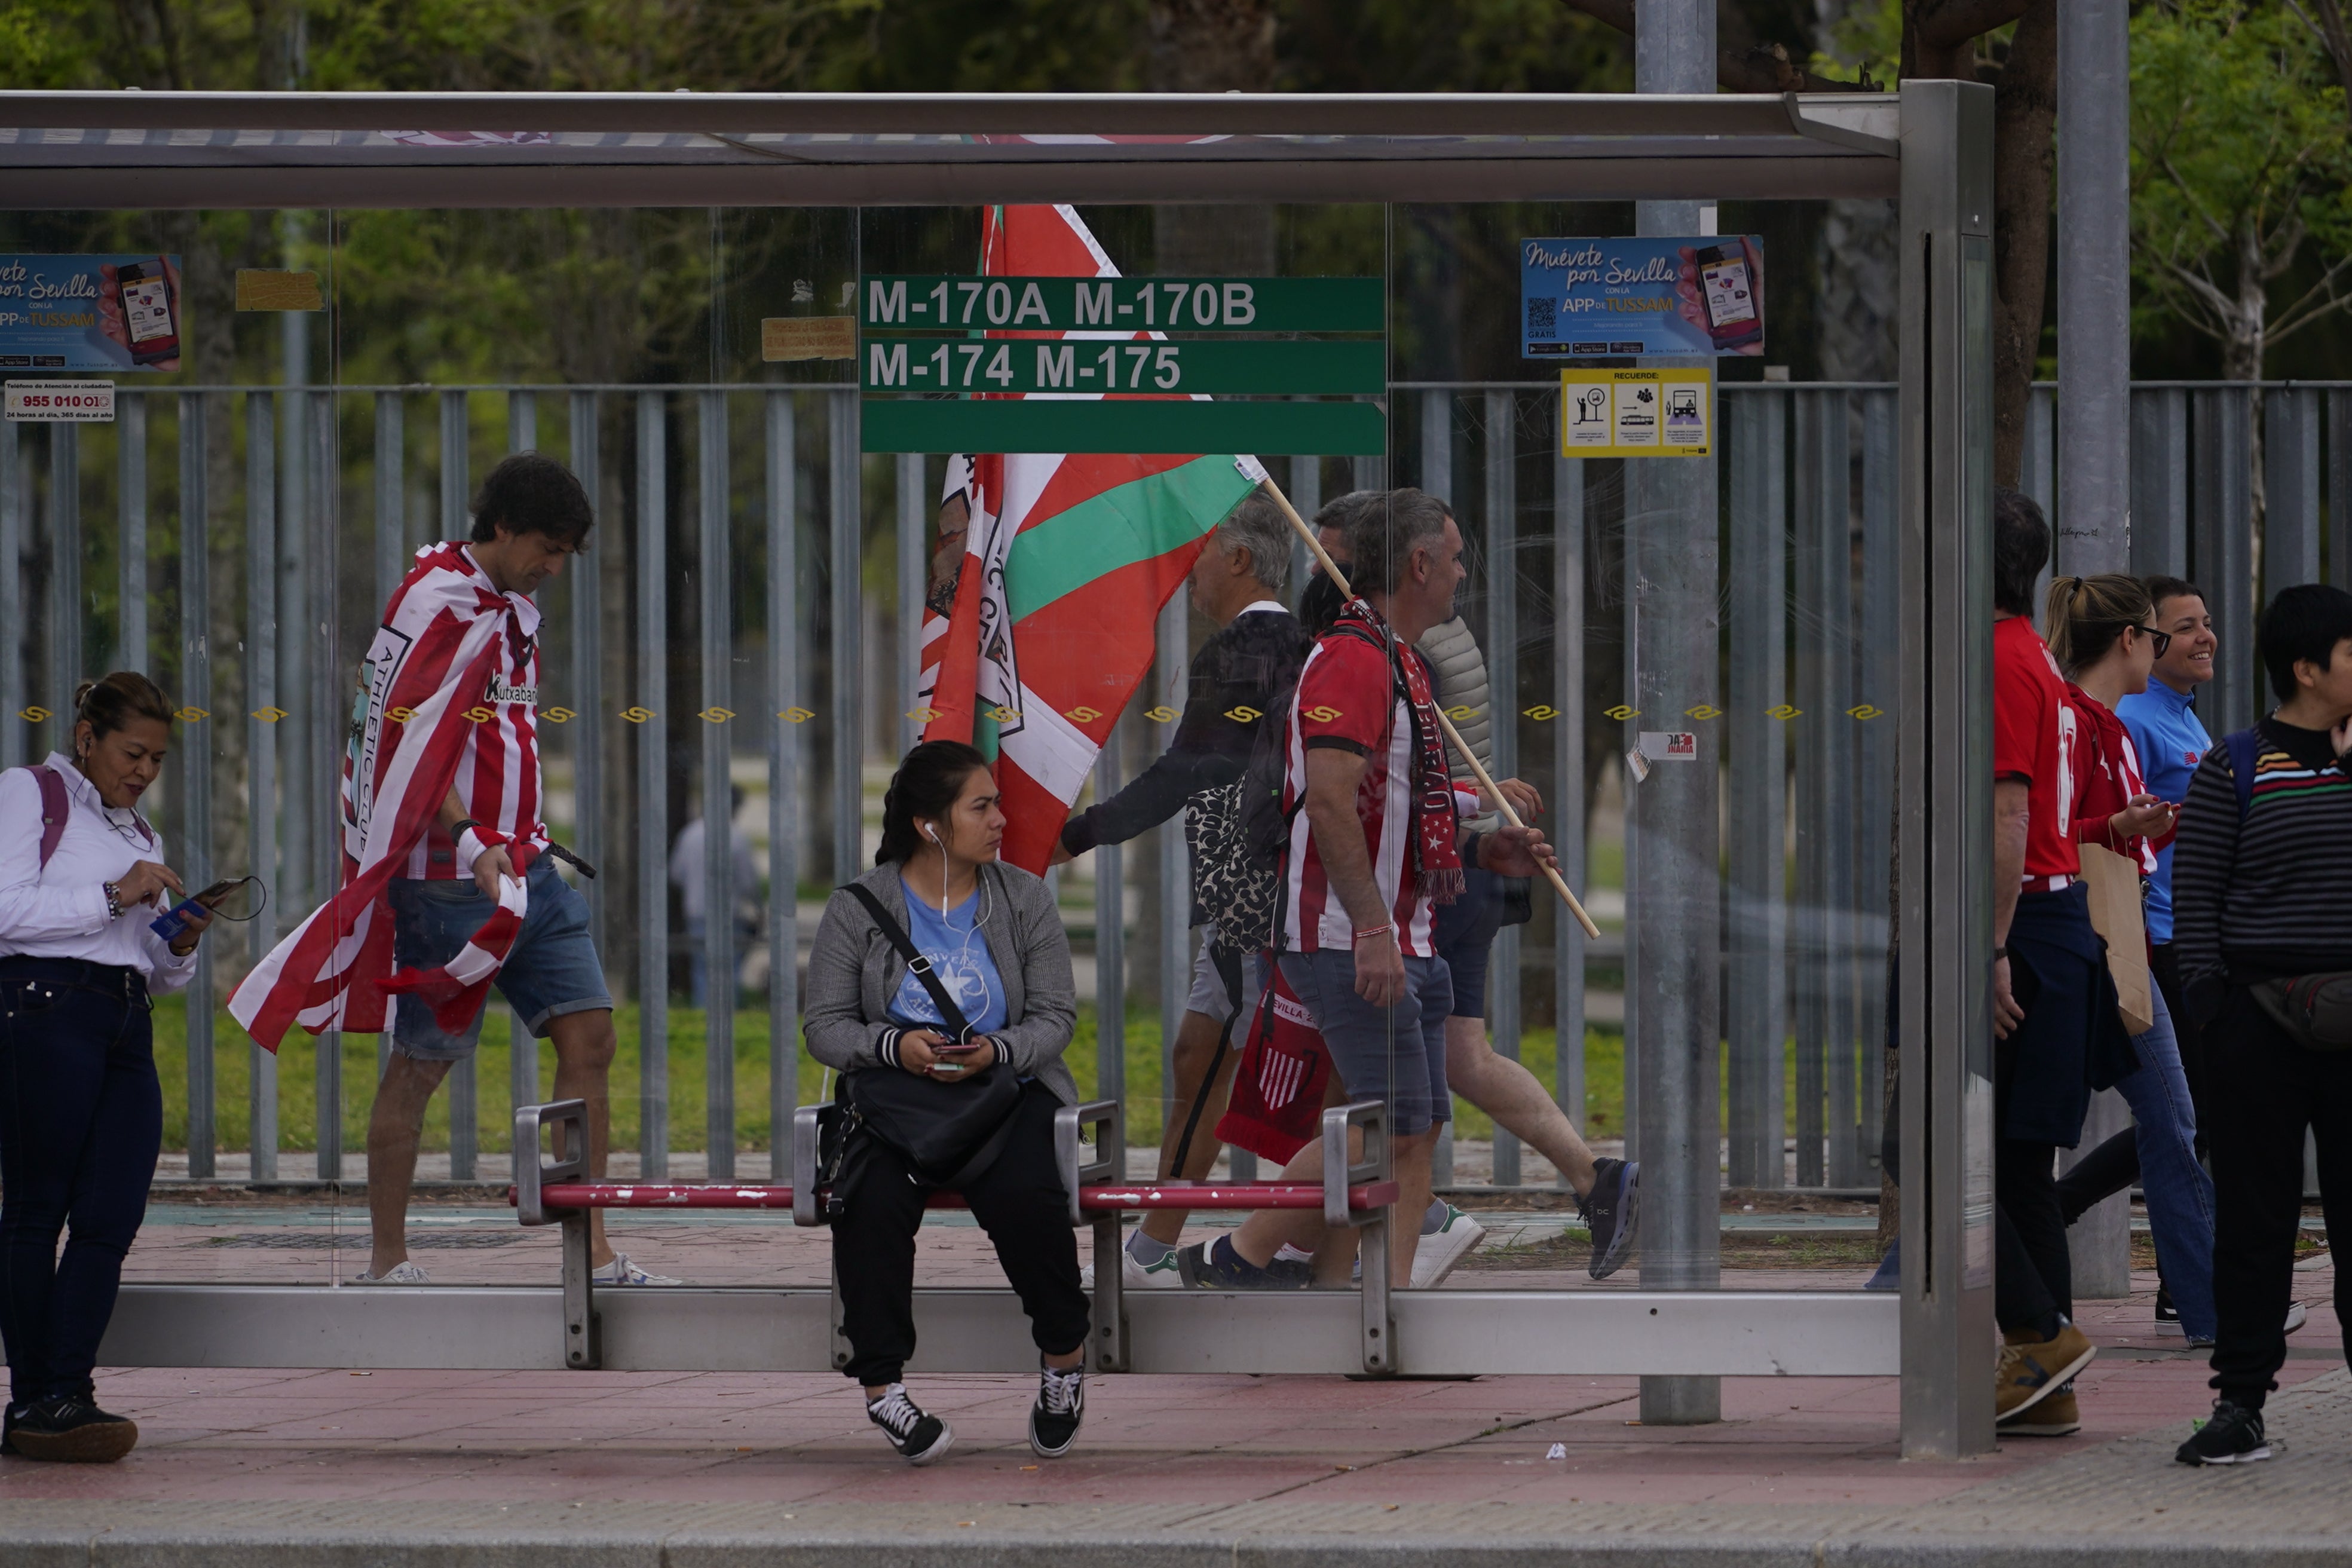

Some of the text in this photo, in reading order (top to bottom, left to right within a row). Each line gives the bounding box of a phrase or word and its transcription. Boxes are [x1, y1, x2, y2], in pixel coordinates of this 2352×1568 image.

[1526, 242, 1604, 271] Muévete
[28, 273, 98, 299] Sevilla
[1567, 257, 1676, 291] por Sevilla
[870, 281, 1255, 324] M-170A M-170B
[1563, 298, 1595, 313] APP
[1606, 297, 1673, 313] TUSSAM
[30, 312, 95, 327] TUSSAM
[871, 344, 1180, 388] M-174 M-175
[23, 396, 50, 407] 955
[54, 396, 81, 407] 010
[365, 646, 393, 774] ATHLETIC
